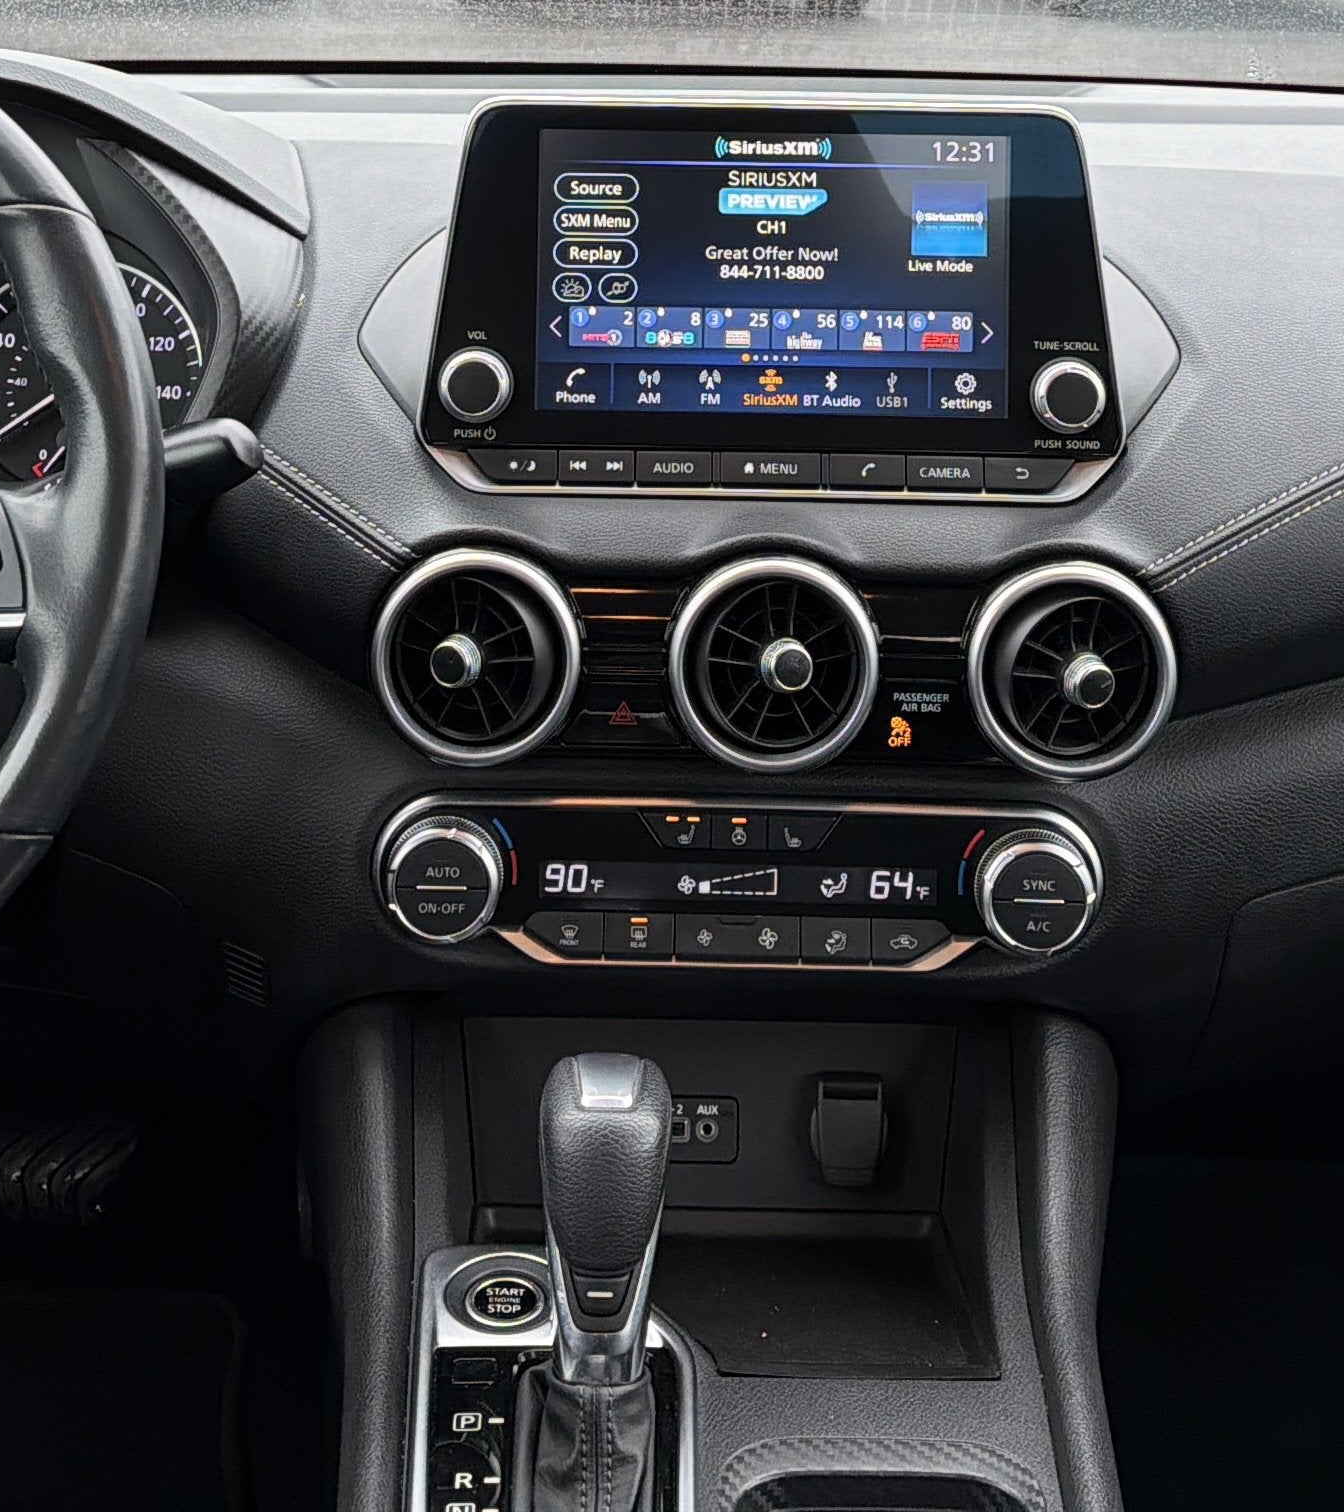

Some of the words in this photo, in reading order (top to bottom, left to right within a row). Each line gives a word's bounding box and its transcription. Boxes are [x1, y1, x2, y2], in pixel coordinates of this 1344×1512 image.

[932, 141, 995, 163] 12:31
[727, 169, 817, 187] SIRIUSXM
[570, 180, 623, 196] Source
[727, 194, 818, 210] PREVIEW
[560, 213, 591, 228] SXM
[593, 213, 631, 229] Menu
[756, 220, 788, 235] CH1
[569, 246, 623, 264] Replay
[705, 245, 749, 261] Great
[752, 245, 794, 261] Offer
[798, 246, 839, 262] Now!
[719, 264, 825, 281] 844-711-8800
[908, 260, 933, 273] Live
[936, 260, 975, 273] Mode
[623, 310, 634, 326] 2
[690, 311, 702, 327] 8
[748, 312, 769, 328] 25
[816, 313, 837, 329] 56
[876, 314, 905, 330] 114
[951, 316, 972, 331] 80
[467, 330, 488, 340] VOL
[147, 336, 175, 352] 120
[156, 385, 182, 400] 140
[555, 390, 596, 404] Phone
[637, 392, 661, 405] AM
[700, 392, 721, 405] FM
[743, 393, 798, 406] SiriusXM
[803, 395, 820, 407] BT
[822, 394, 861, 408] Audio
[876, 395, 908, 408] USB1
[940, 396, 993, 413] Settings
[453, 428, 481, 439] PUSH
[1034, 439, 1062, 449] PUSH
[1065, 440, 1101, 450] SOUND
[653, 462, 695, 474] AUDIO
[760, 463, 798, 475] MENU
[919, 467, 971, 480] CAMERA
[893, 692, 950, 703] PASSENGER
[900, 702, 919, 712] AIR
[920, 703, 942, 713] BAG
[888, 736, 912, 748] OFF
[425, 866, 461, 878] AUTO
[1022, 878, 1056, 892] SYNC
[1026, 921, 1051, 933] A/C
[559, 939, 580, 947] FRONT
[696, 1104, 719, 1115] AUX
[485, 1287, 526, 1297] START
[488, 1296, 522, 1304] ENGINE
[487, 1304, 522, 1314] STOP
[460, 1415, 476, 1429] P
[454, 1472, 473, 1489] R
